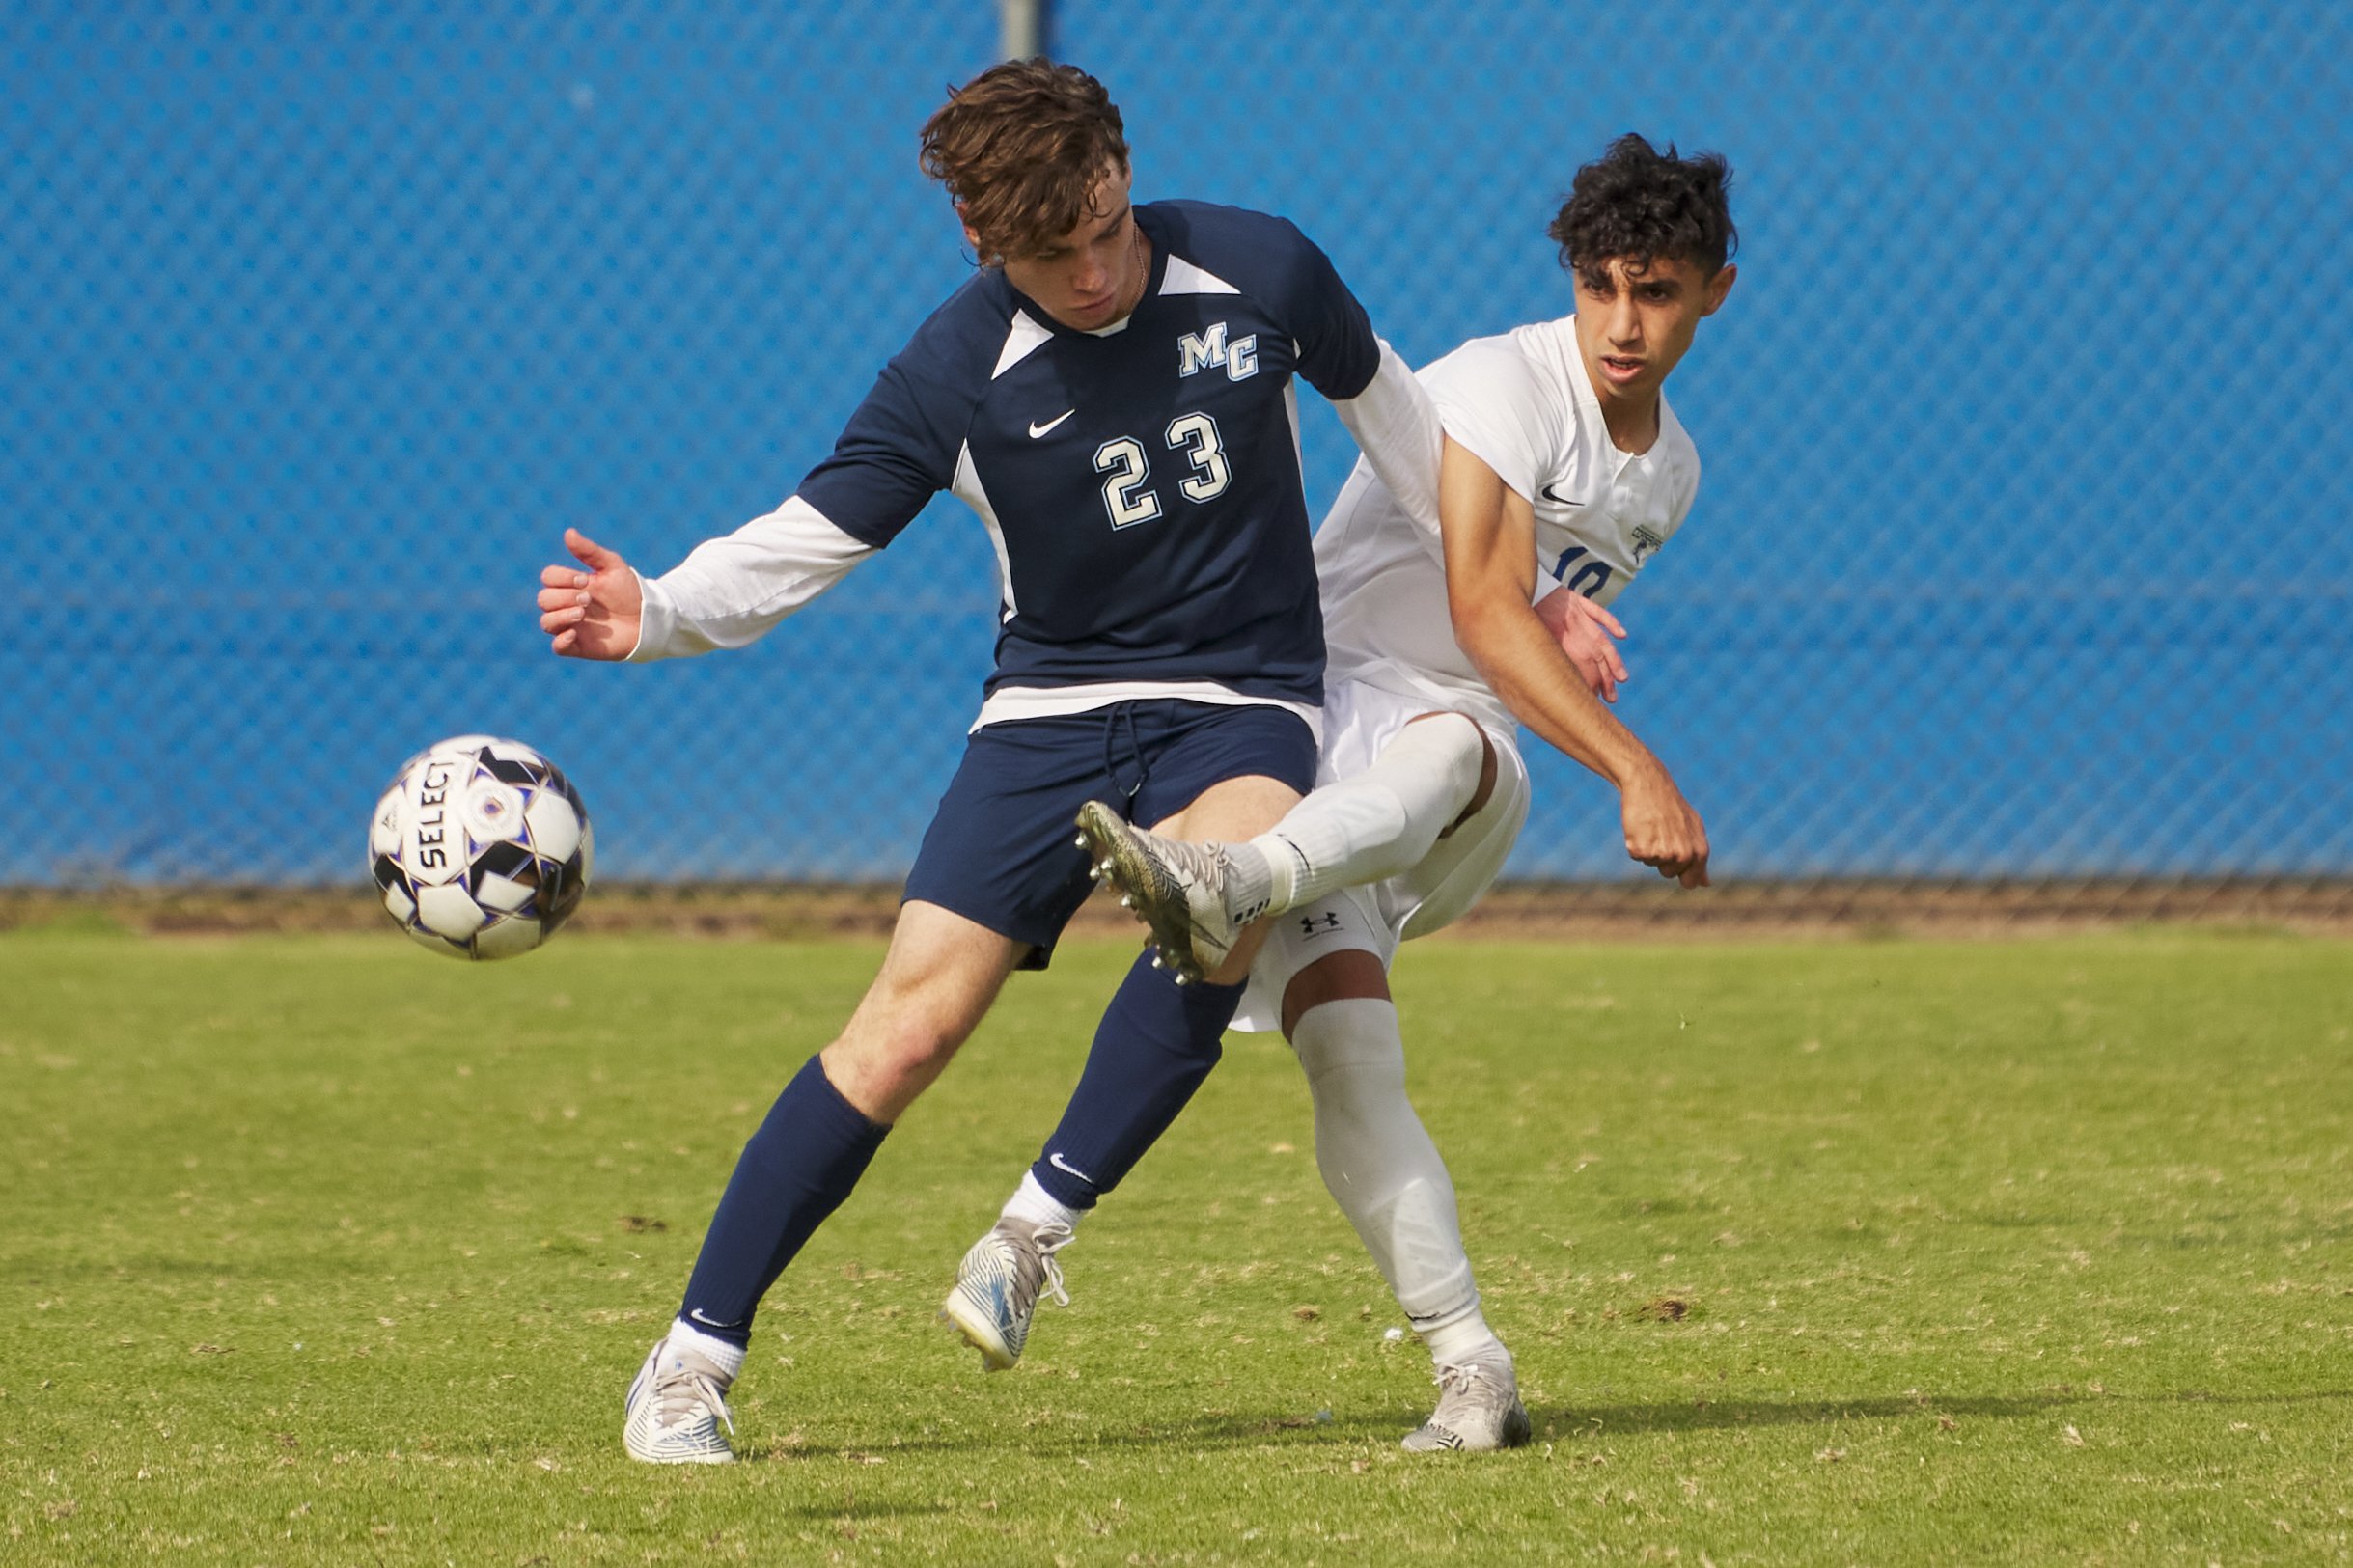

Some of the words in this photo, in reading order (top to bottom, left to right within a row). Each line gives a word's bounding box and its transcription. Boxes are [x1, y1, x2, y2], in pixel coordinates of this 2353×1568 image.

[1177, 321, 1259, 382] MC
[1093, 411, 1232, 531] 23
[418, 761, 454, 868] SELECT
